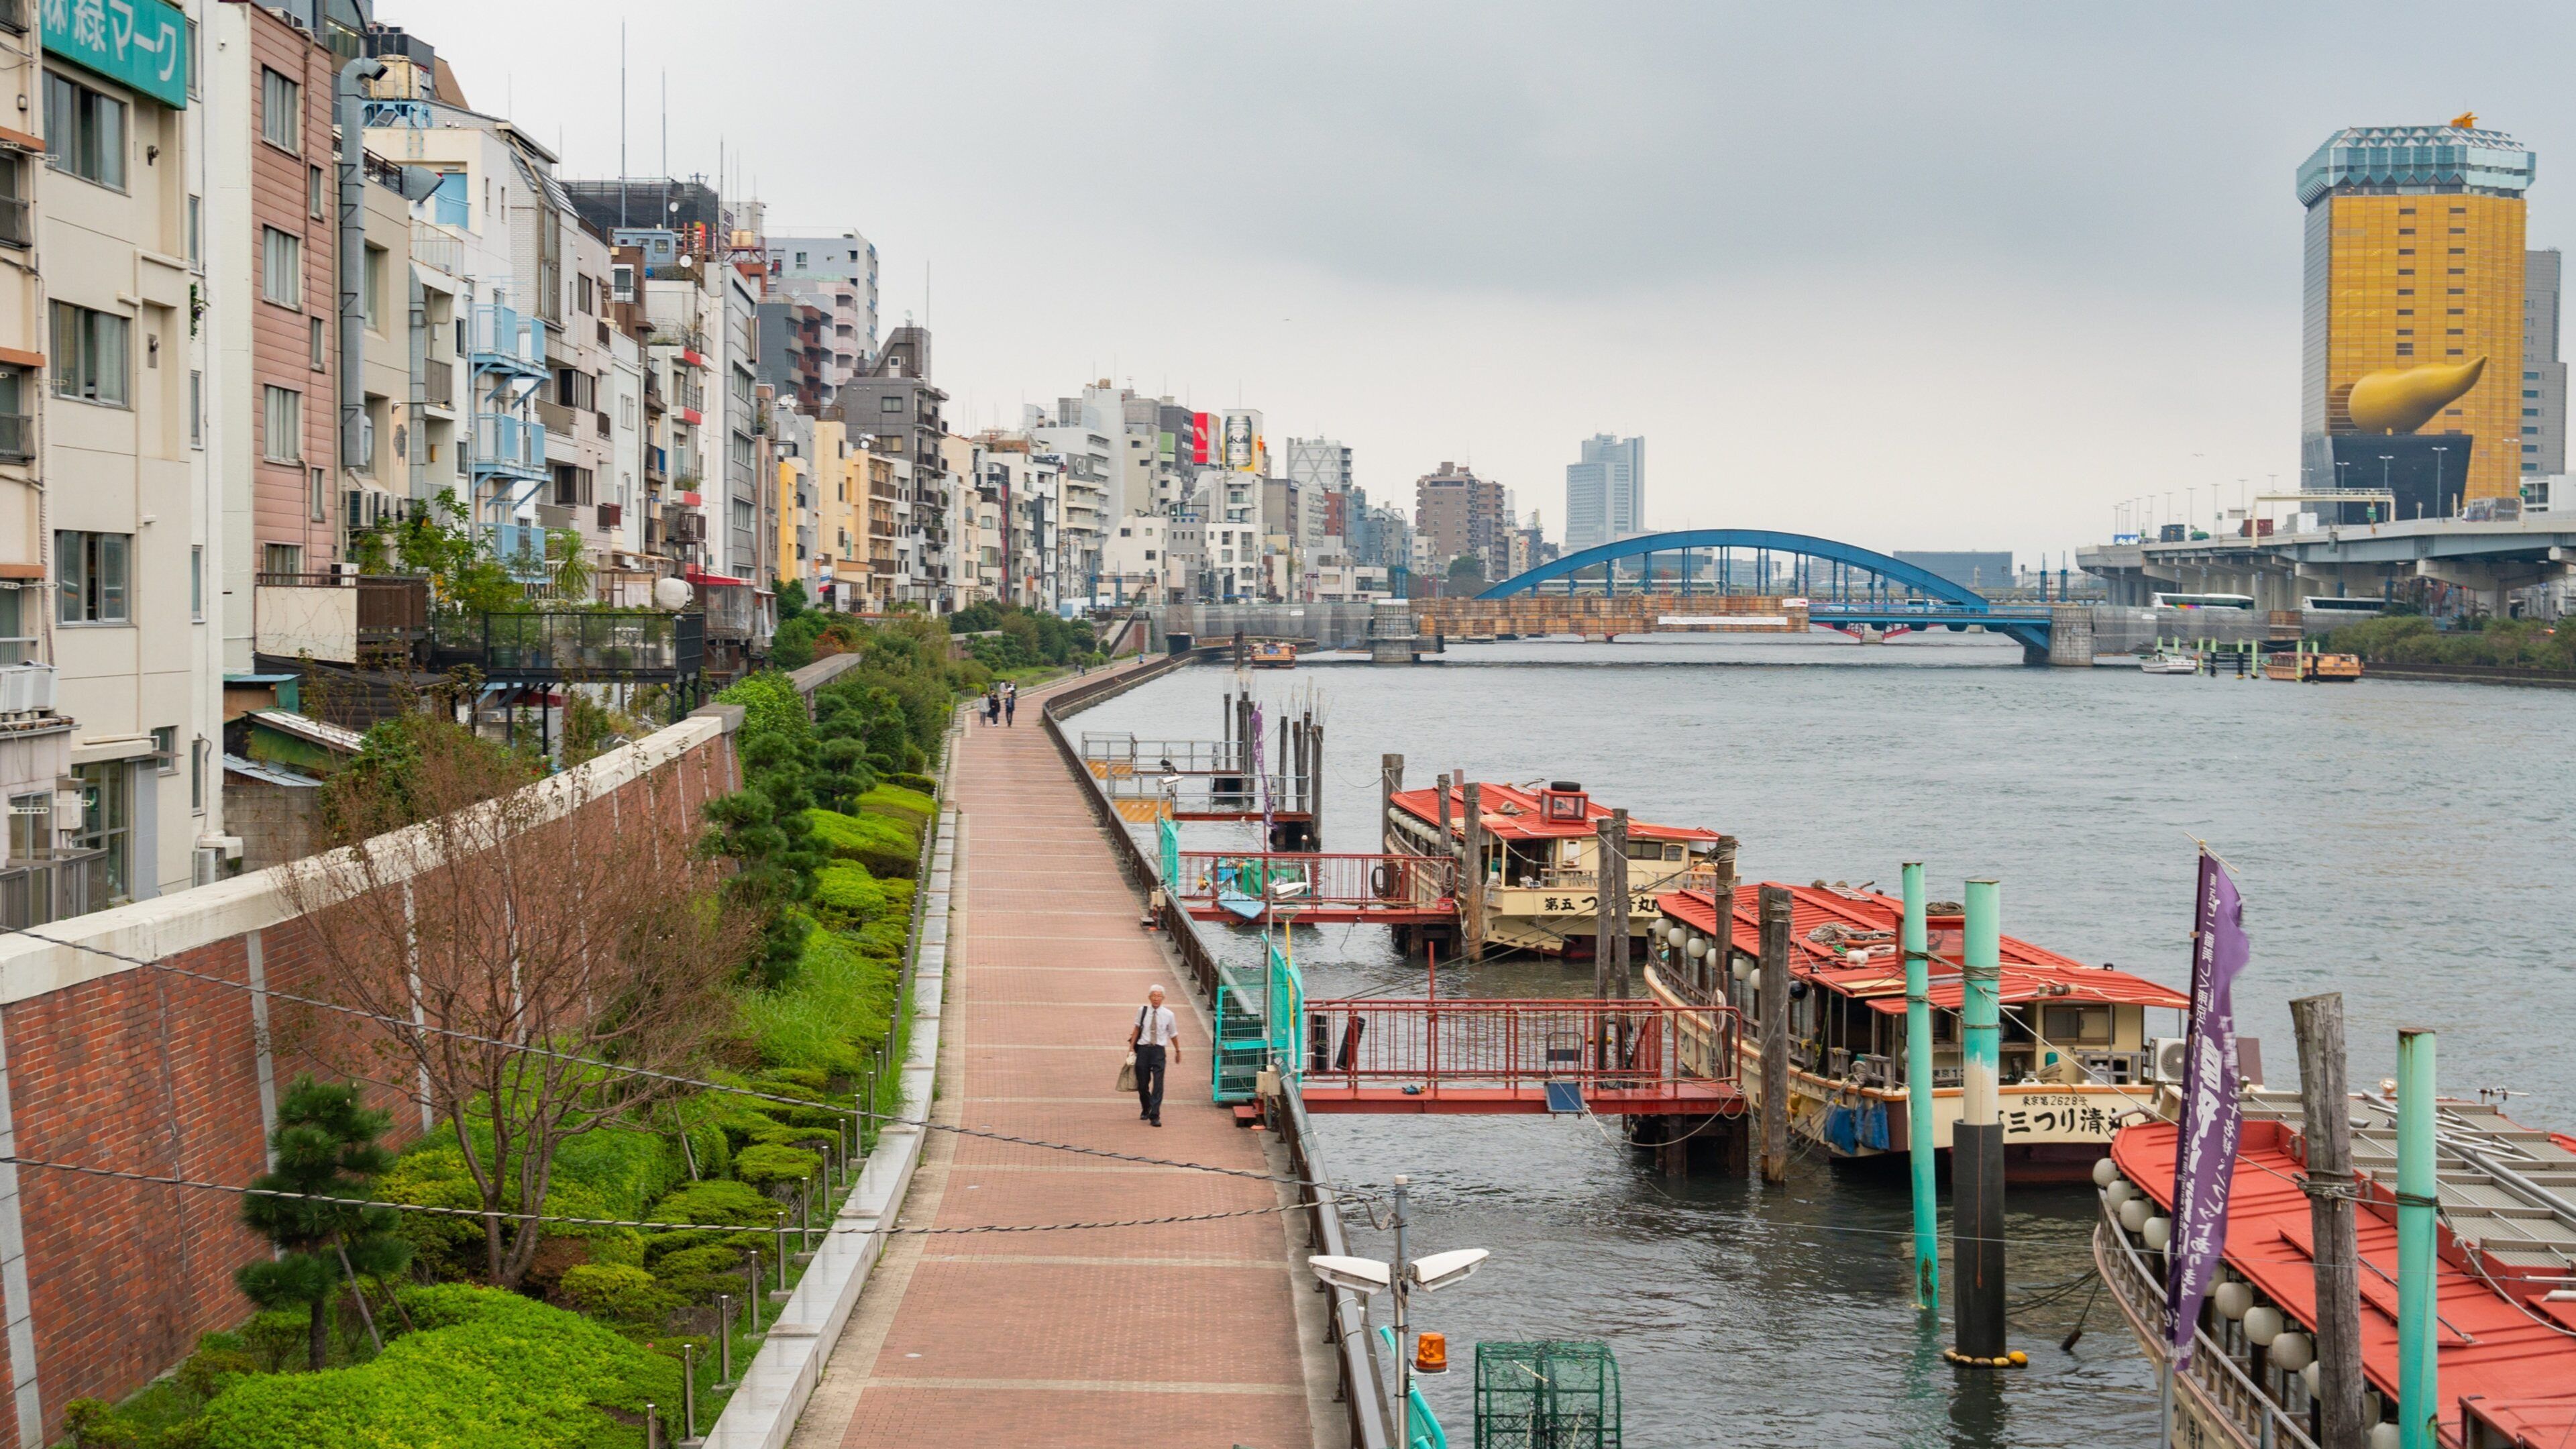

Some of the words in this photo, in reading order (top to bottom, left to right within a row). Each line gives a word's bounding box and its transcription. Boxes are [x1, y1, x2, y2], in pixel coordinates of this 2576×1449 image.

[1998, 1108, 2131, 1135] 三つり清丸
